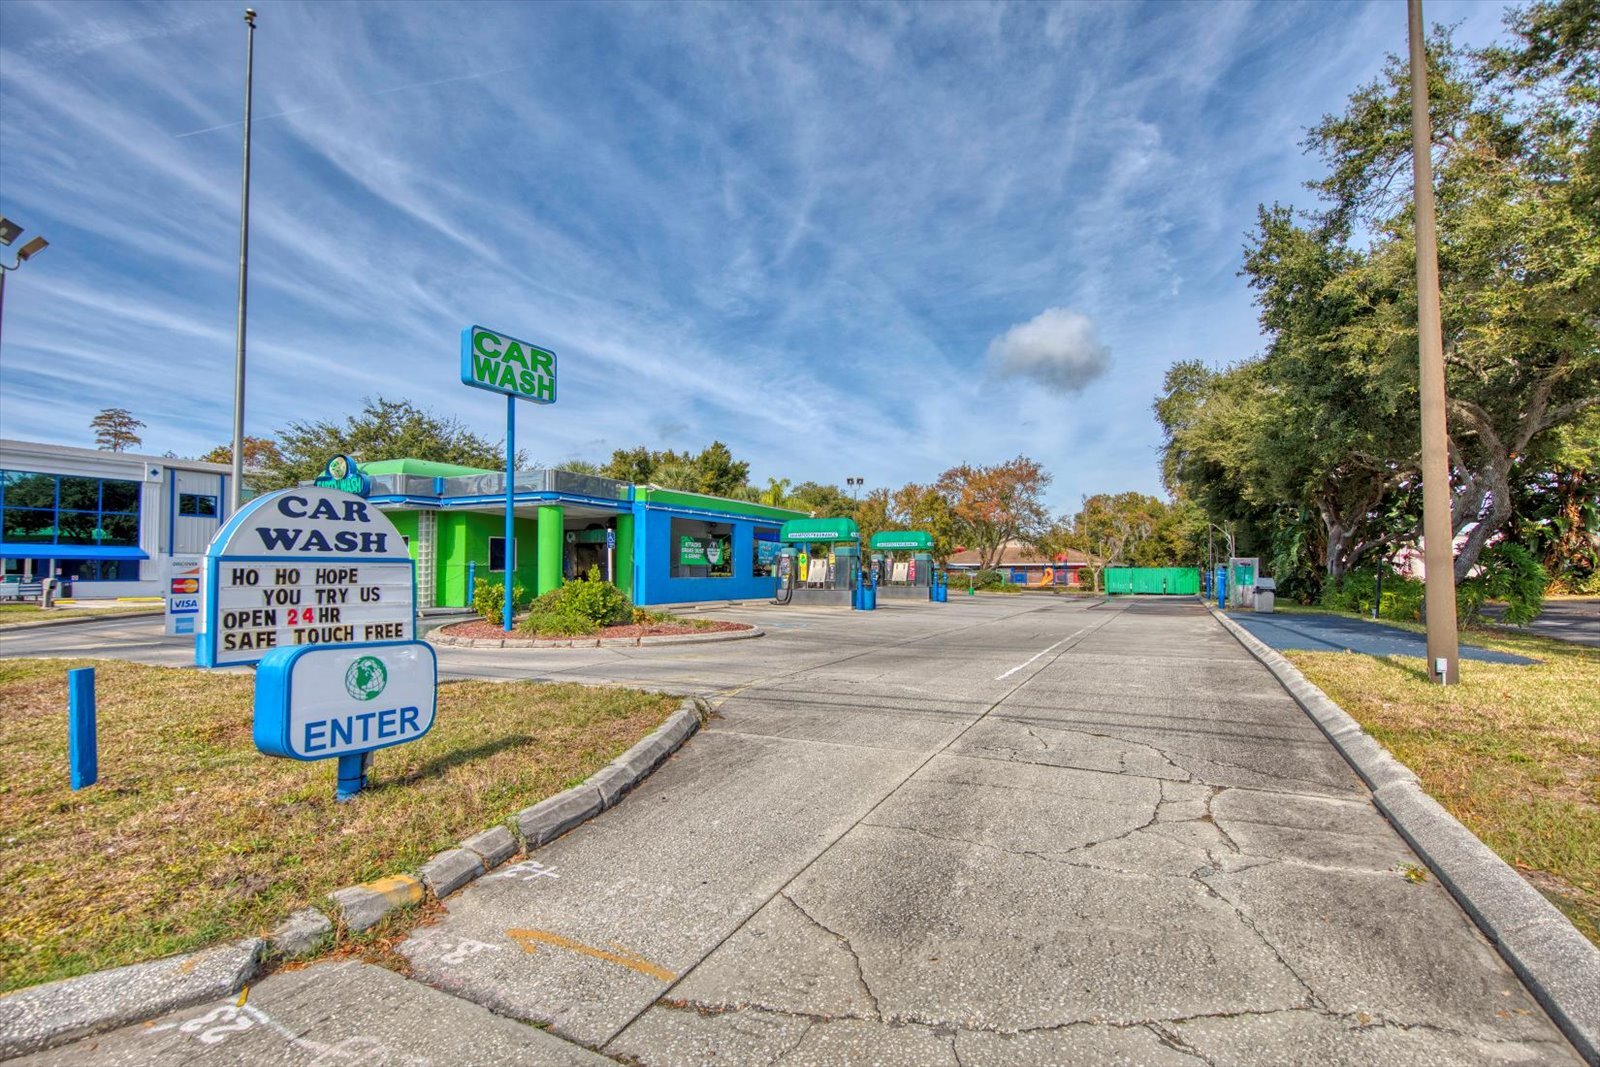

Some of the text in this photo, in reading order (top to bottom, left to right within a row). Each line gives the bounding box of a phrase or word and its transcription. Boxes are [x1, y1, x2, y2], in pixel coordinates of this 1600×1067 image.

[474, 332, 554, 378] CAR
[473, 354, 555, 401] WASH
[277, 495, 371, 522] CAR
[256, 527, 388, 553] WASH
[232, 568, 358, 586] HO HO HOPE
[175, 600, 198, 608] VISA
[263, 586, 381, 606] YOU TRY US
[223, 607, 341, 629] OPEN 24 HR
[224, 623, 403, 650] SAFE TOUCH FREE
[304, 706, 421, 753] ENTER
